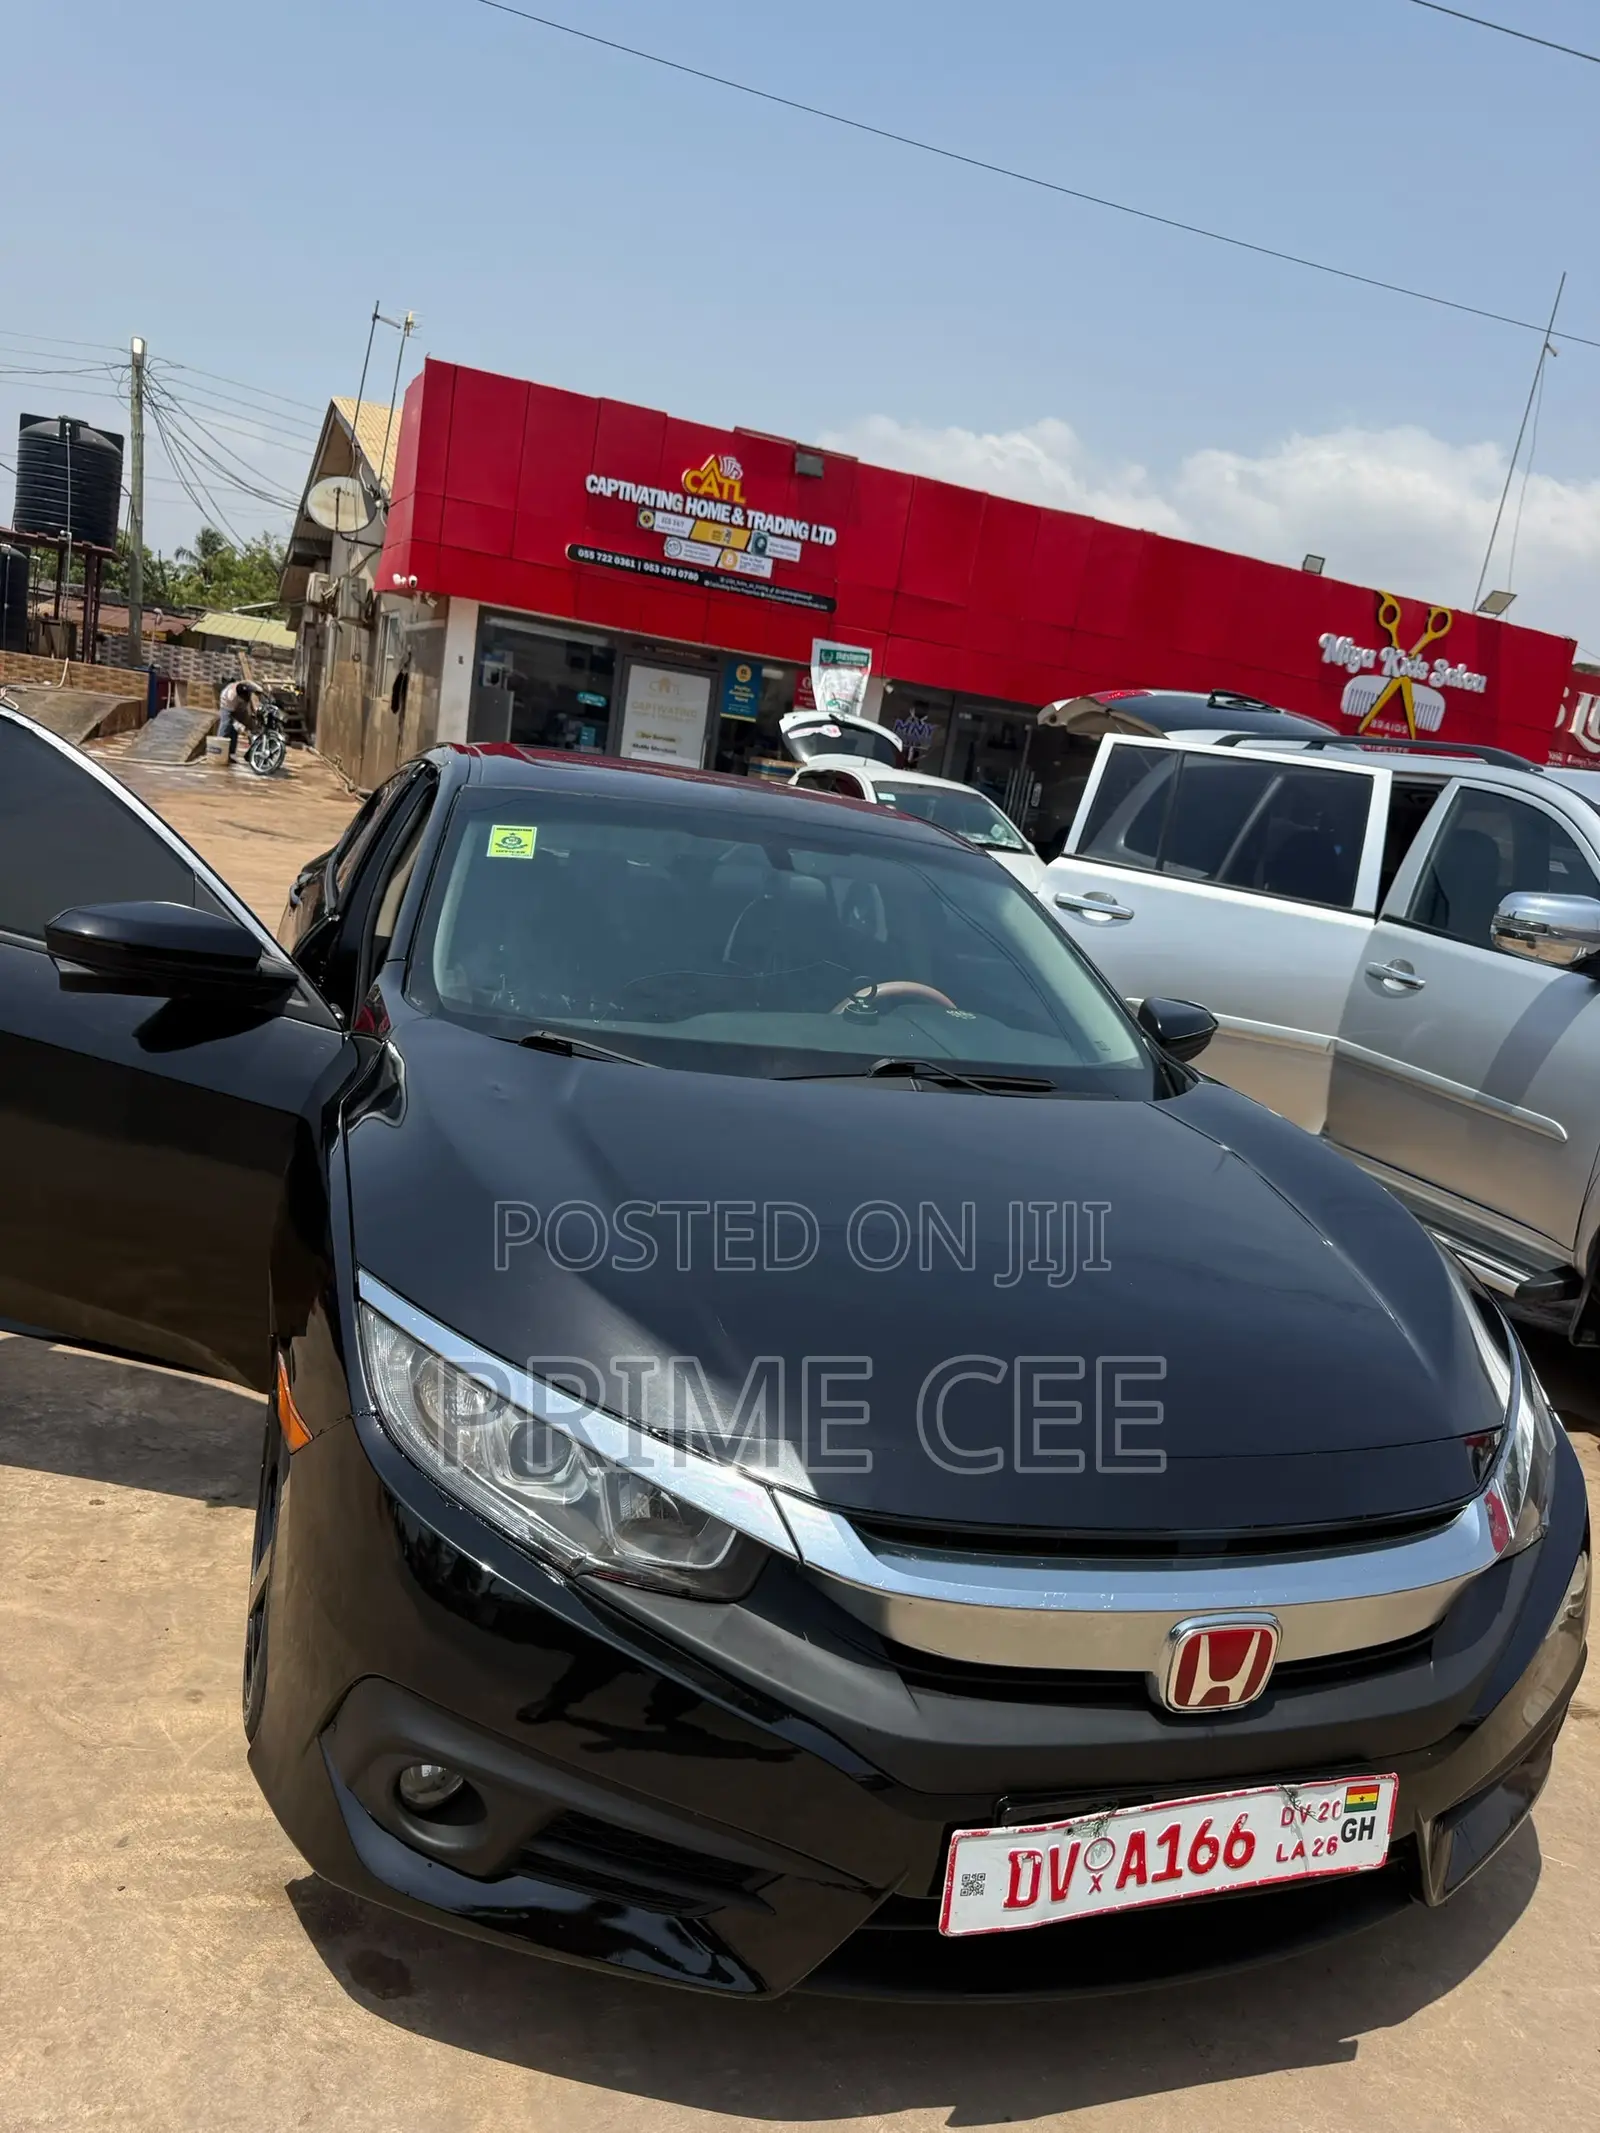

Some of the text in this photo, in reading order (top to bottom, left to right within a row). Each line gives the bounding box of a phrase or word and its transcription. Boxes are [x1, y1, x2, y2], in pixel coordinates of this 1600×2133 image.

[682, 455, 746, 503] CATL
[585, 474, 684, 513] CAPTIVATING
[685, 496, 731, 524] HOME
[731, 507, 745, 526] &
[747, 510, 809, 540] TRADING
[811, 524, 837, 546] LTD
[597, 552, 613, 563] 722
[1379, 647, 1430, 680] Kids
[1429, 659, 1487, 693] Salon
[1115, 1811, 1257, 1890] A166
[1276, 1834, 1339, 1863] LA 26
[1340, 1816, 1376, 1843] GH
